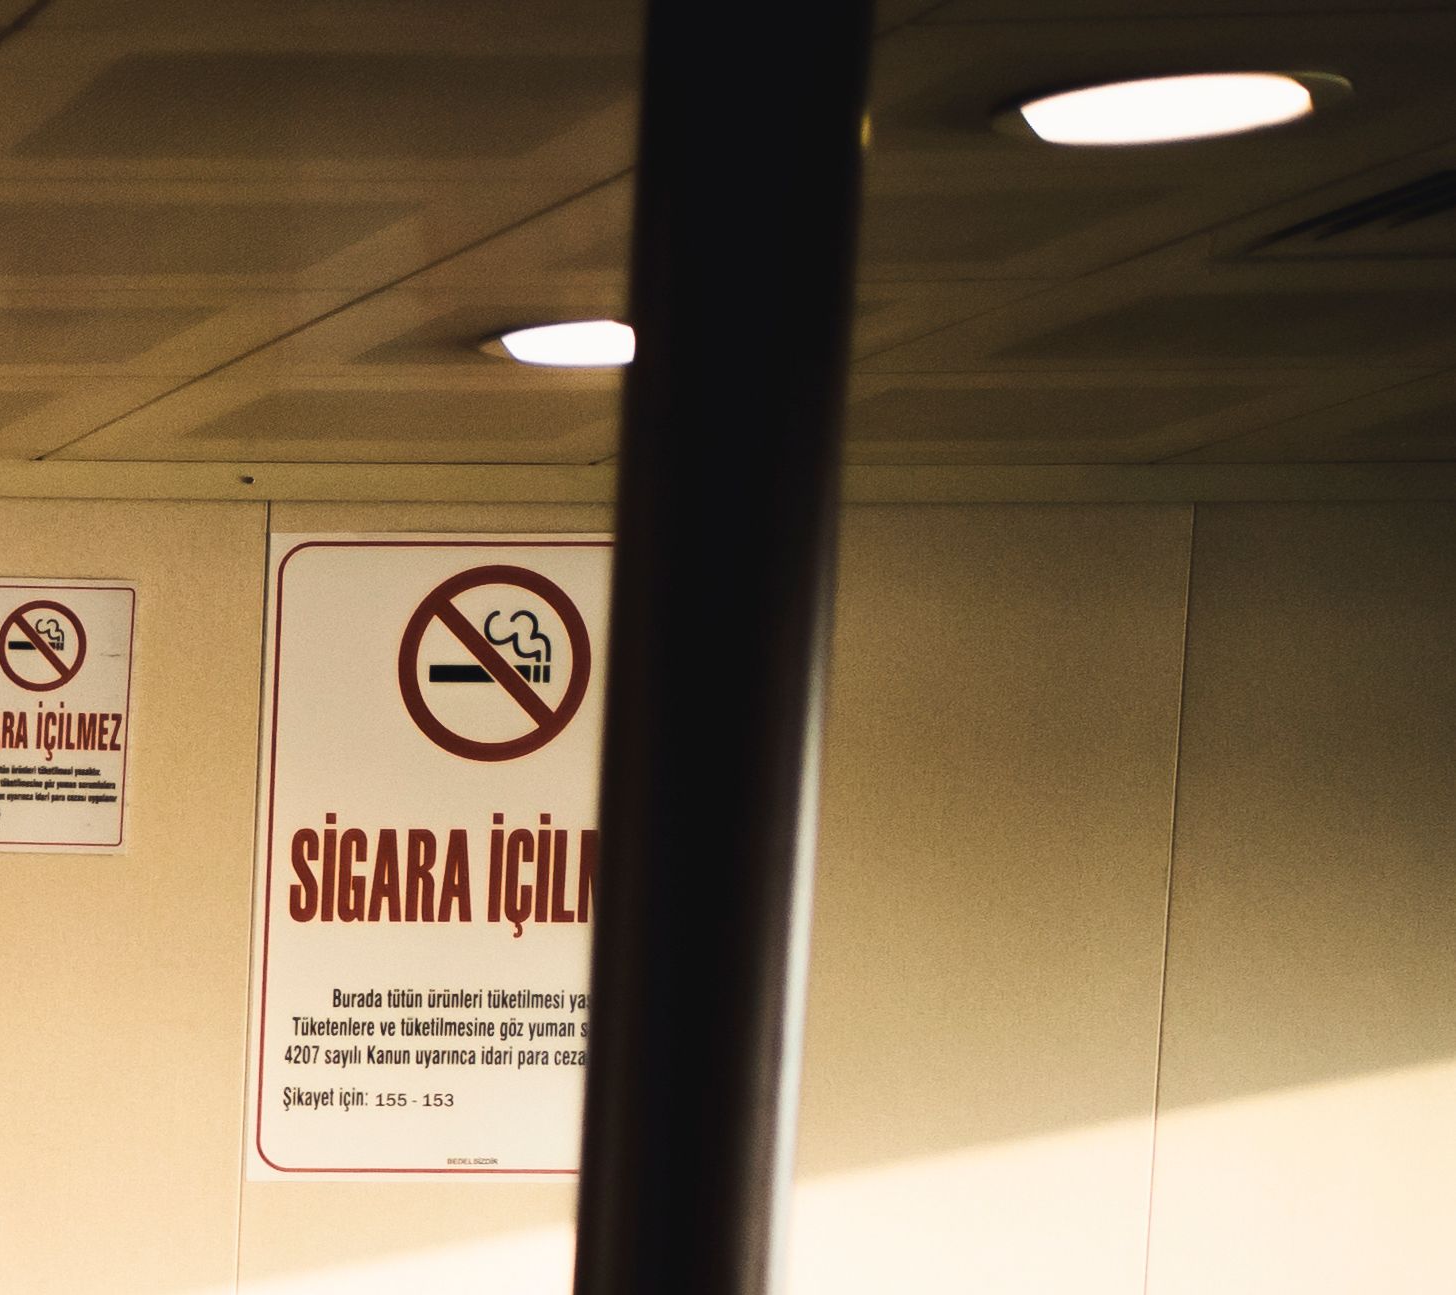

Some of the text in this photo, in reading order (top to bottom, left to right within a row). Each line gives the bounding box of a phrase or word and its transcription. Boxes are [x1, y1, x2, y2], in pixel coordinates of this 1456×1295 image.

[35, 701, 122, 761] İÇİLMEZ
[289, 812, 472, 924] SİGARA
[332, 988, 382, 1008] Burada
[387, 988, 423, 1009] tütün
[427, 989, 483, 1009] ürünleri
[487, 989, 565, 1009] tüketilmesi
[292, 1016, 375, 1036] Tüketenlere
[380, 1021, 396, 1036] ve
[400, 1017, 495, 1037] tüketilmesine
[500, 1018, 524, 1041] göz
[529, 1021, 575, 1041] yuman
[284, 1045, 320, 1064] 4207
[324, 1045, 361, 1068] sayılı
[367, 1045, 411, 1065] Kanun
[415, 1049, 476, 1069] uyarınca
[481, 1046, 513, 1065] idari
[518, 1050, 549, 1070] para
[283, 1086, 334, 1111] Şikayet
[339, 1087, 369, 1112] için:
[375, 1093, 407, 1107] 155
[422, 1093, 454, 1107] 153
